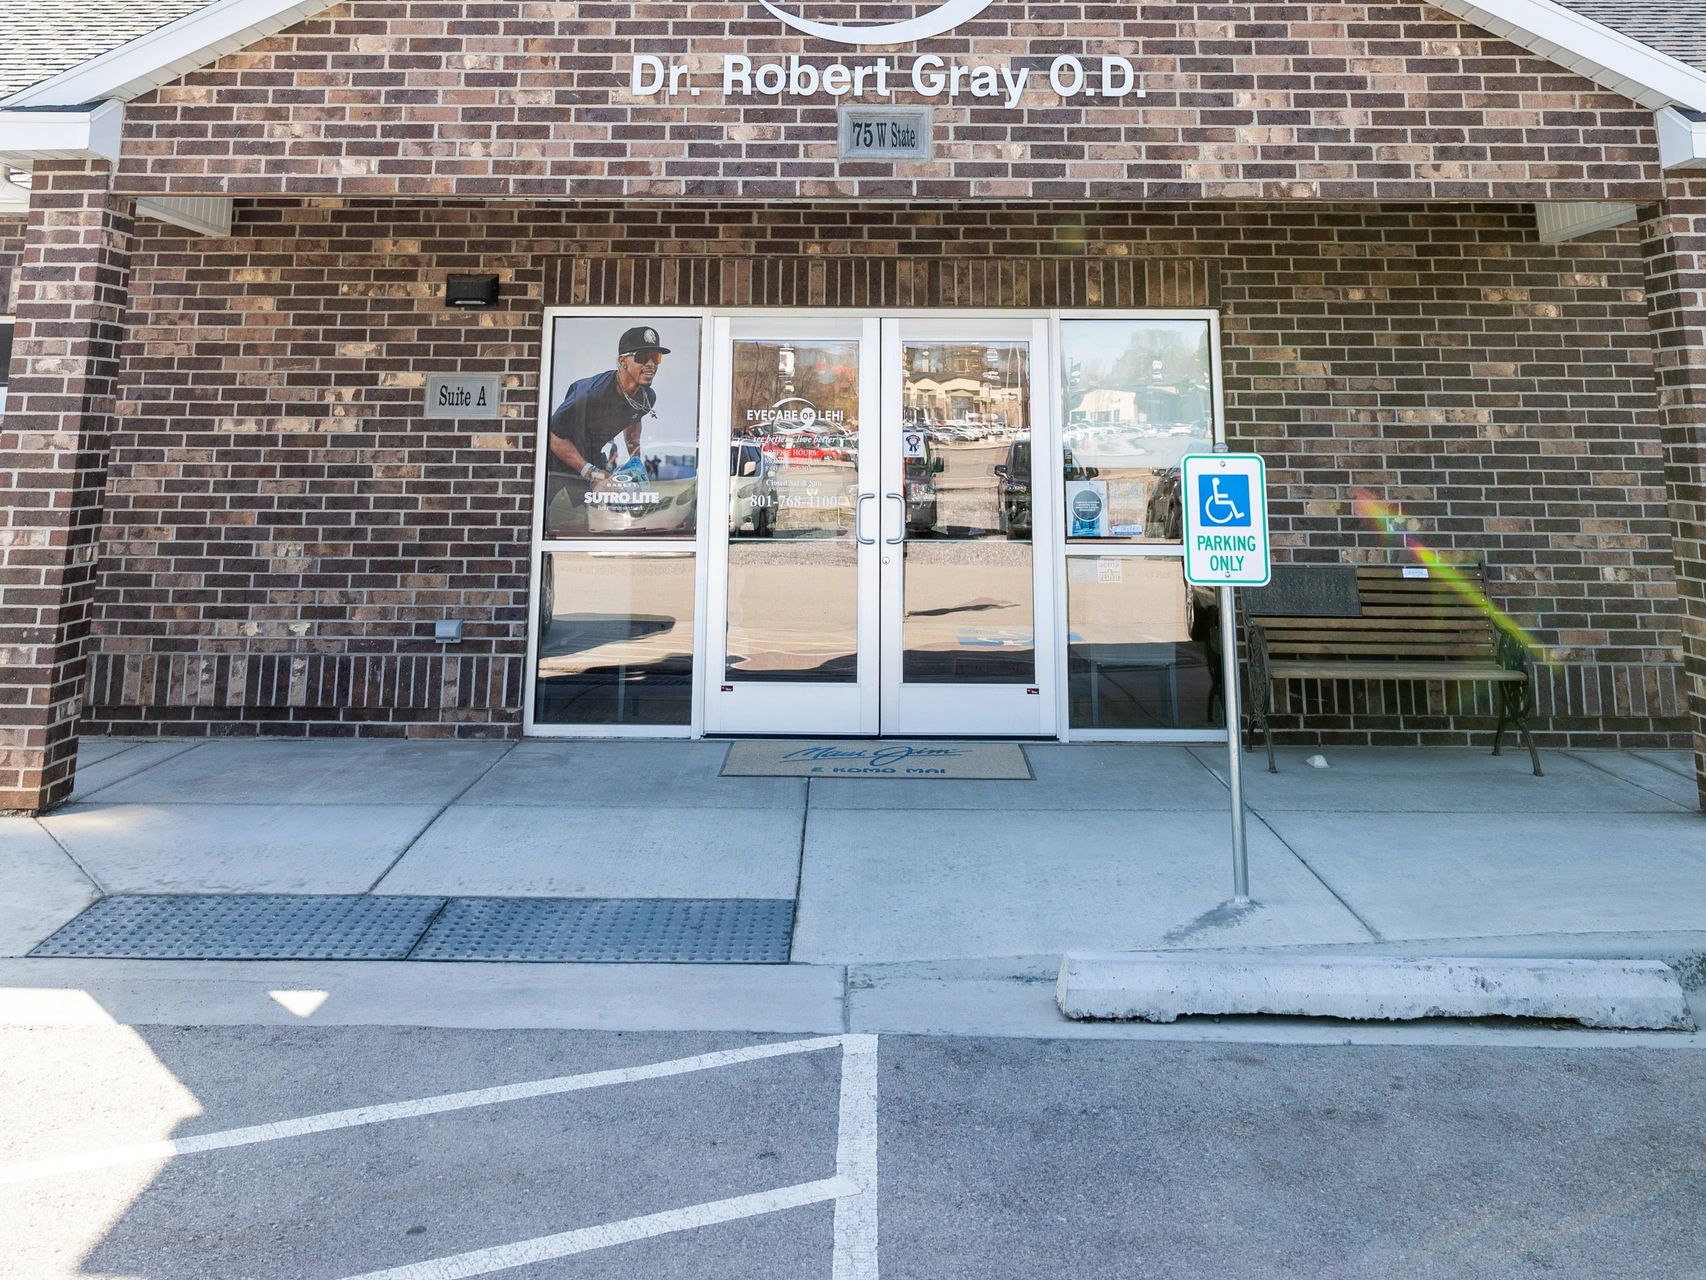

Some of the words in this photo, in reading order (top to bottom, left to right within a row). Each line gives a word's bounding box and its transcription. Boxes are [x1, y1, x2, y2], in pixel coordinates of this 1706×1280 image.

[631, 54, 700, 96] Dr.
[723, 54, 891, 97] Robert
[911, 54, 1030, 109] Gray
[1049, 55, 1147, 98] O.D.
[852, 122, 874, 148] 75
[876, 122, 887, 148] W
[891, 121, 916, 148] State
[439, 384, 472, 407] Suite
[476, 385, 487, 407] A
[746, 410, 798, 420] EYECARE
[818, 410, 844, 421] LEHI
[583, 491, 630, 504] SUTRO
[632, 491, 660, 504] LITE
[1197, 535, 1256, 552] PARKING
[1210, 555, 1245, 572] ONLY
[782, 746, 868, 760] Maui
[905, 767, 947, 775] MAI
